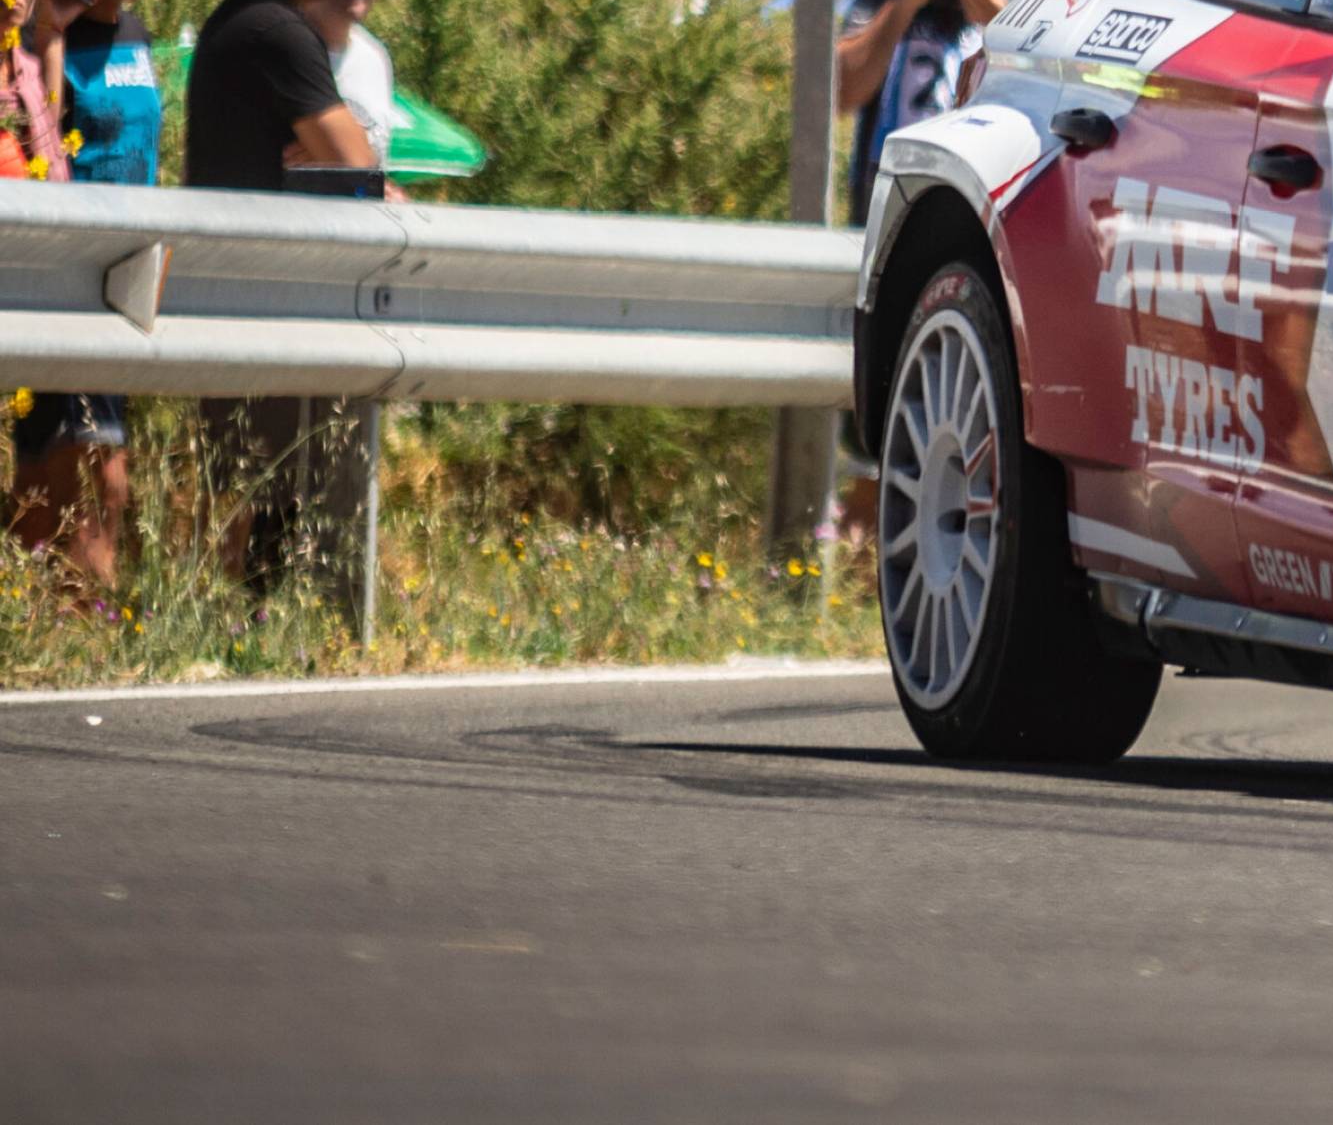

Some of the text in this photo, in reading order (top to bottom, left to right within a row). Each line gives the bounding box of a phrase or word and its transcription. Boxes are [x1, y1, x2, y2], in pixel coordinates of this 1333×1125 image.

[1096, 176, 1296, 343] MRF
[1125, 345, 1266, 474] TYRES
[1249, 542, 1320, 597] GREEN
